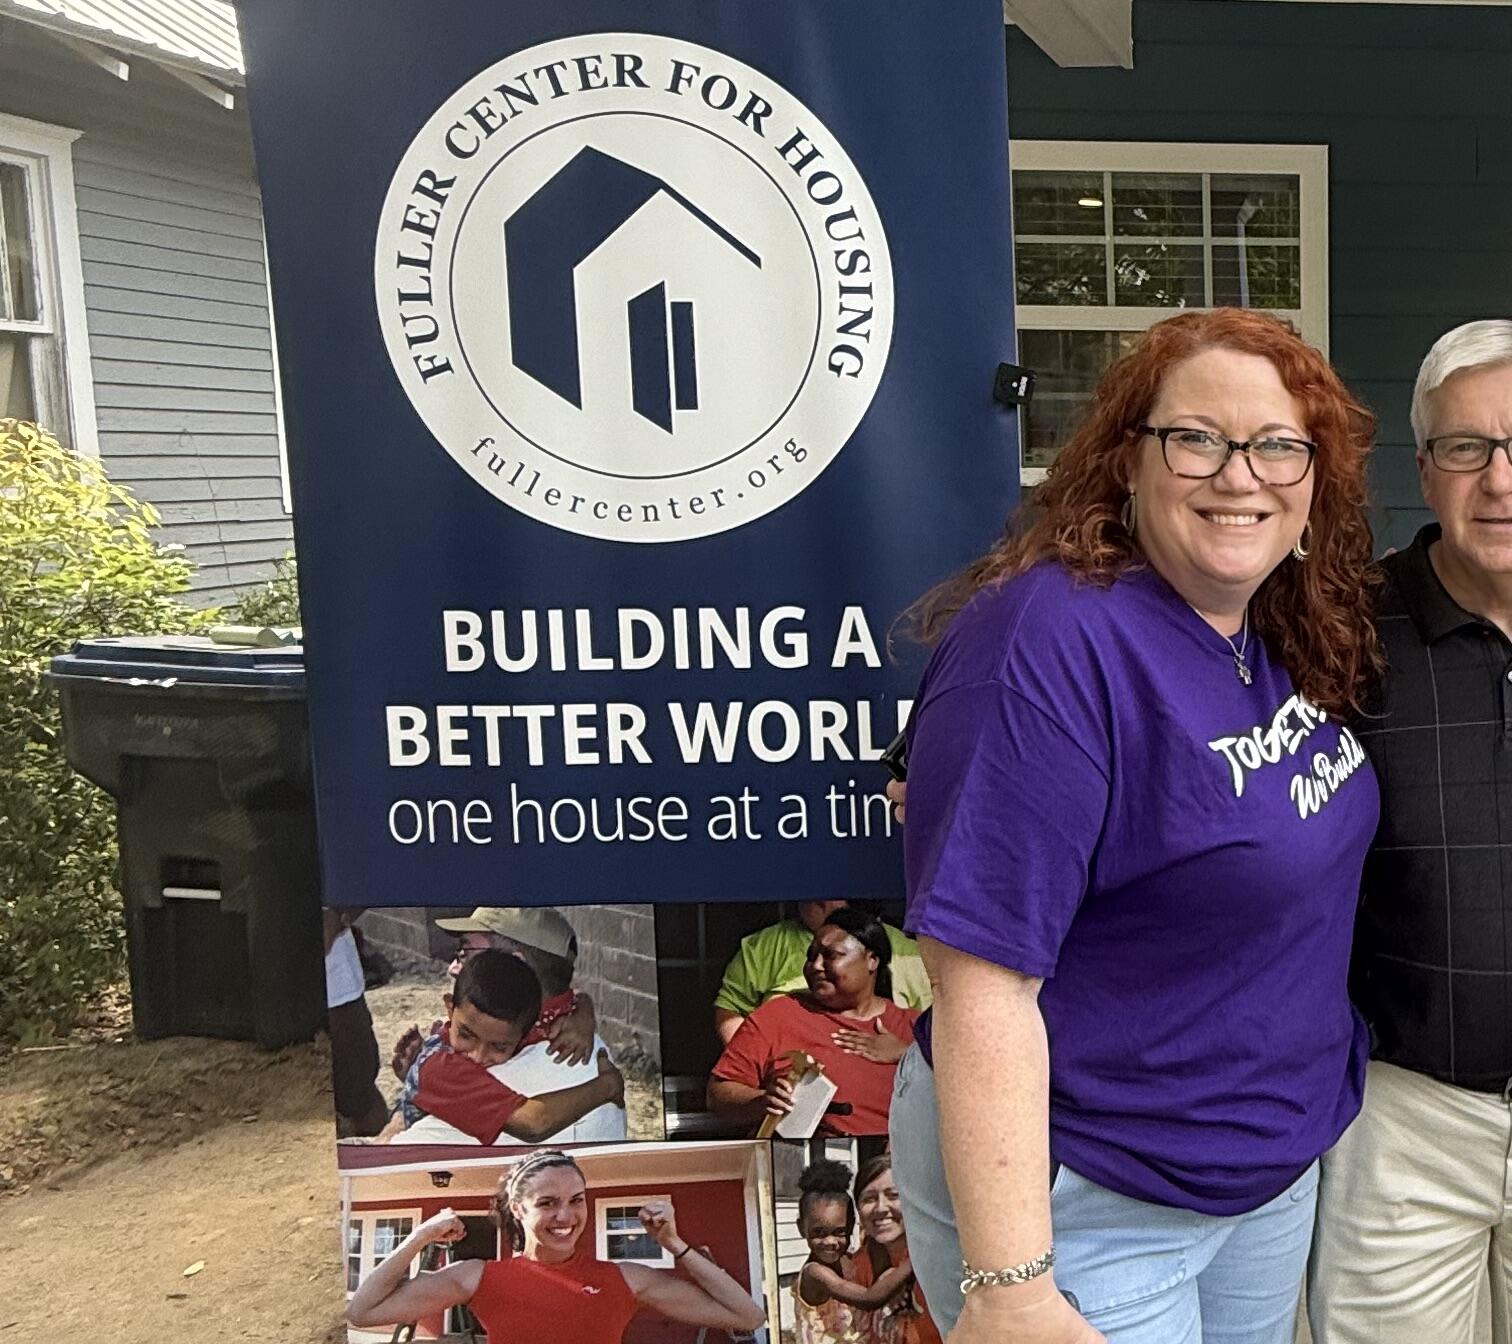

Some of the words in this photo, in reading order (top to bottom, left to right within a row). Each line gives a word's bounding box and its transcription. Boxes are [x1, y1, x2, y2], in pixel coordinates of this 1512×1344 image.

[397, 169, 456, 385] FULLER
[445, 53, 651, 160] CENTER
[664, 59, 773, 138] FOR
[775, 126, 874, 379] HOUSING
[470, 436, 809, 523] fullercenter.org
[442, 605, 809, 673] BUILDING
[831, 605, 882, 669] A
[385, 702, 653, 767] BETTER
[1313, 726, 1365, 793] Build
[388, 799, 492, 844] one
[510, 782, 689, 844] house
[707, 786, 762, 841] at
[777, 794, 808, 839] a
